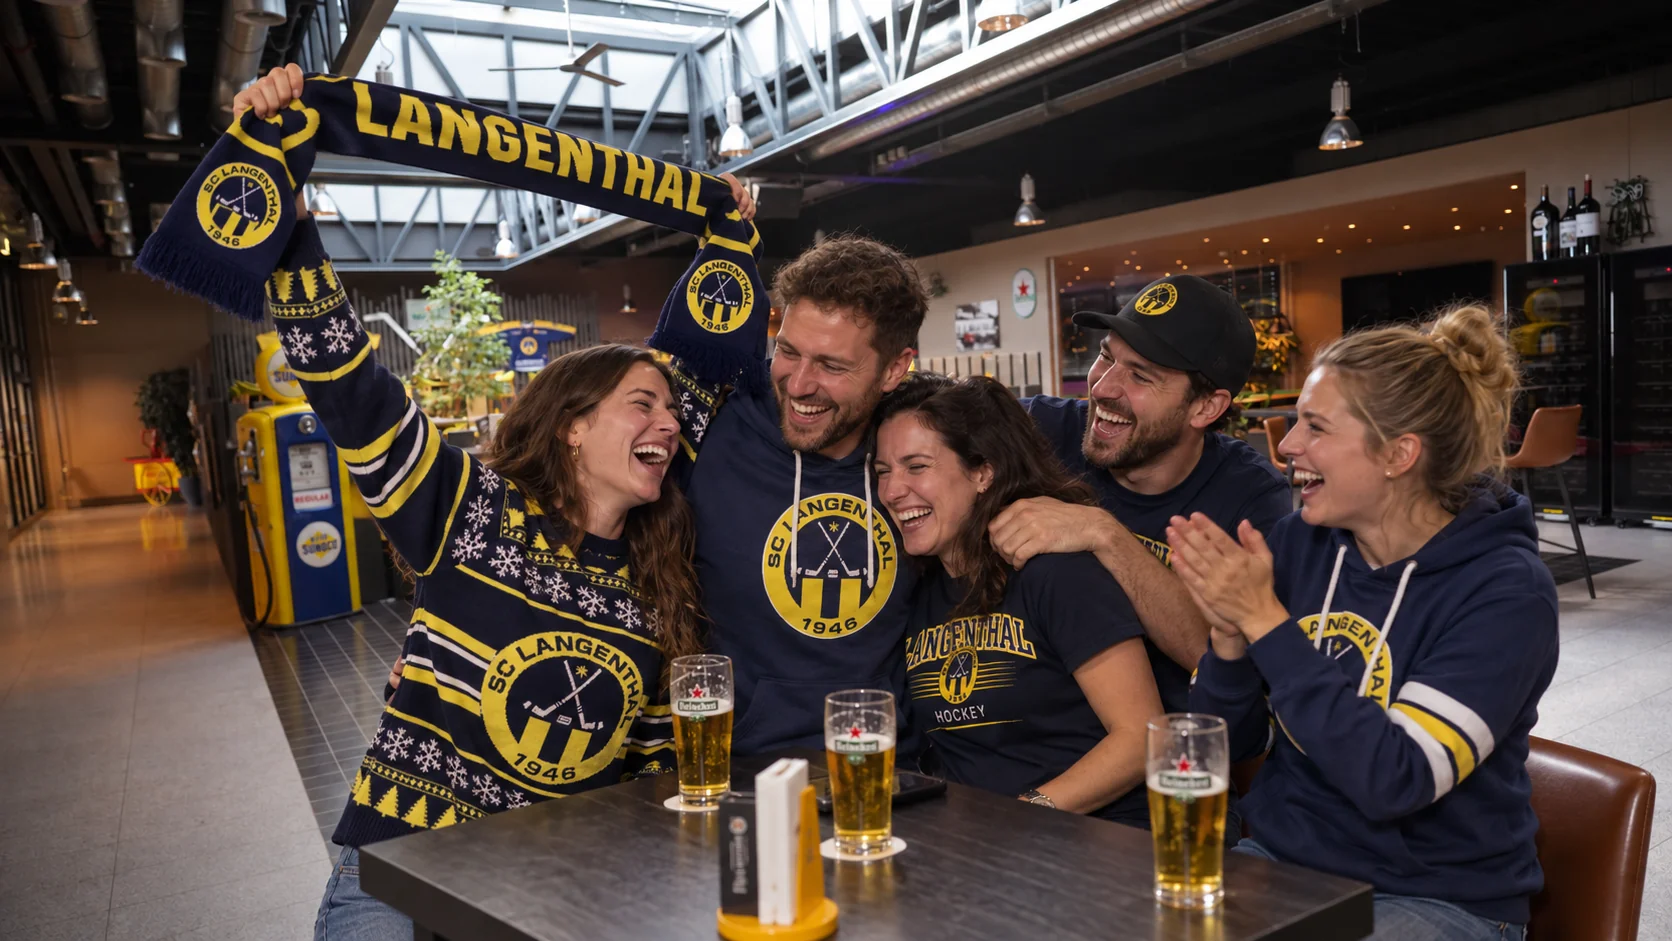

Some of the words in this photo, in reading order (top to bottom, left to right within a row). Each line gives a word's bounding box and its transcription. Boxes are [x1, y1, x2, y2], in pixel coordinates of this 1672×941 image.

[353, 82, 708, 217] LANGENTHAL
[203, 175, 220, 193] SC
[221, 165, 278, 226] LANGENTHAL
[207, 225, 240, 246] 1946
[689, 276, 700, 294] SC
[701, 318, 729, 331] 1946
[768, 536, 785, 569] SC
[802, 617, 858, 634] 1946
[488, 659, 516, 694] SC
[515, 635, 640, 729] LANGENTHAL
[934, 704, 986, 723] HOCKEY
[513, 753, 576, 781] 1946
